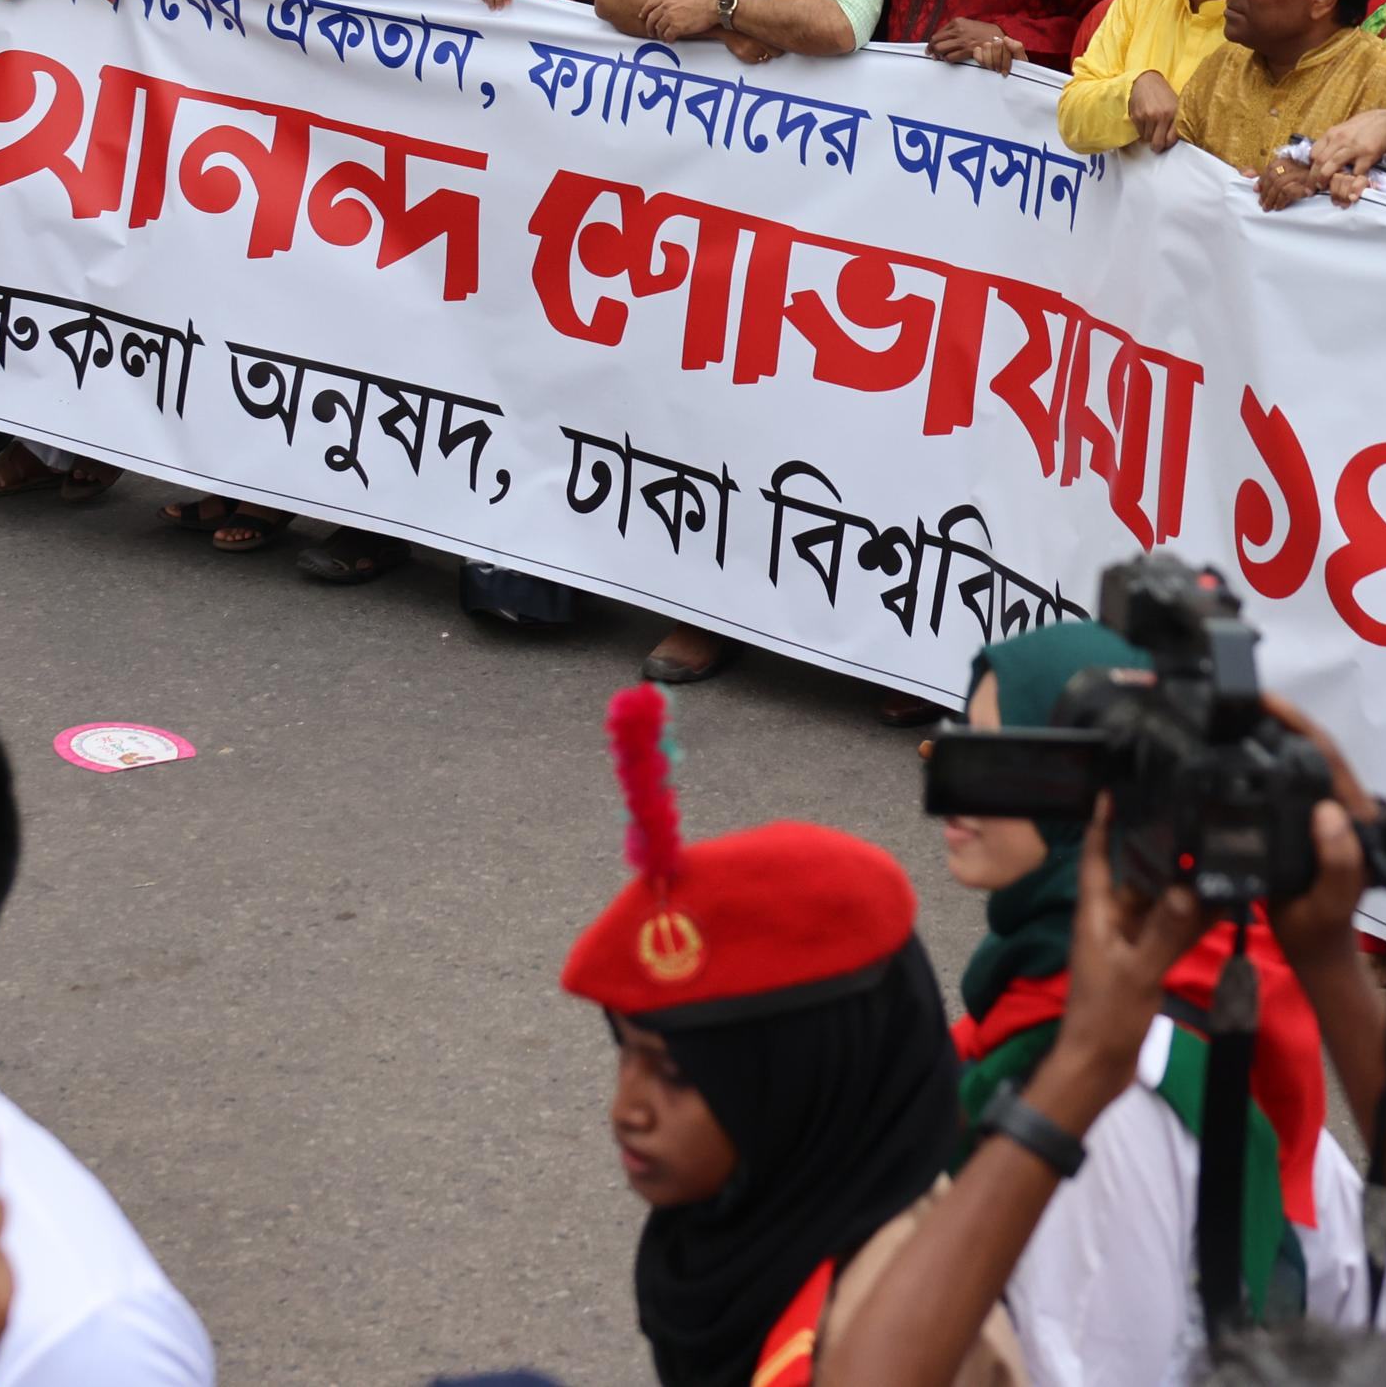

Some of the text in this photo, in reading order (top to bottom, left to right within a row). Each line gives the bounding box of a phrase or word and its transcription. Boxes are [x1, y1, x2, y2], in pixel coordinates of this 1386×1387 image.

[528, 41, 872, 175] ফ্যাসিবাদের
[226, 341, 512, 505] অনুষদ,
[559, 425, 740, 570] ঢাকা
[528, 169, 1204, 552] শোভাযাত্রা
